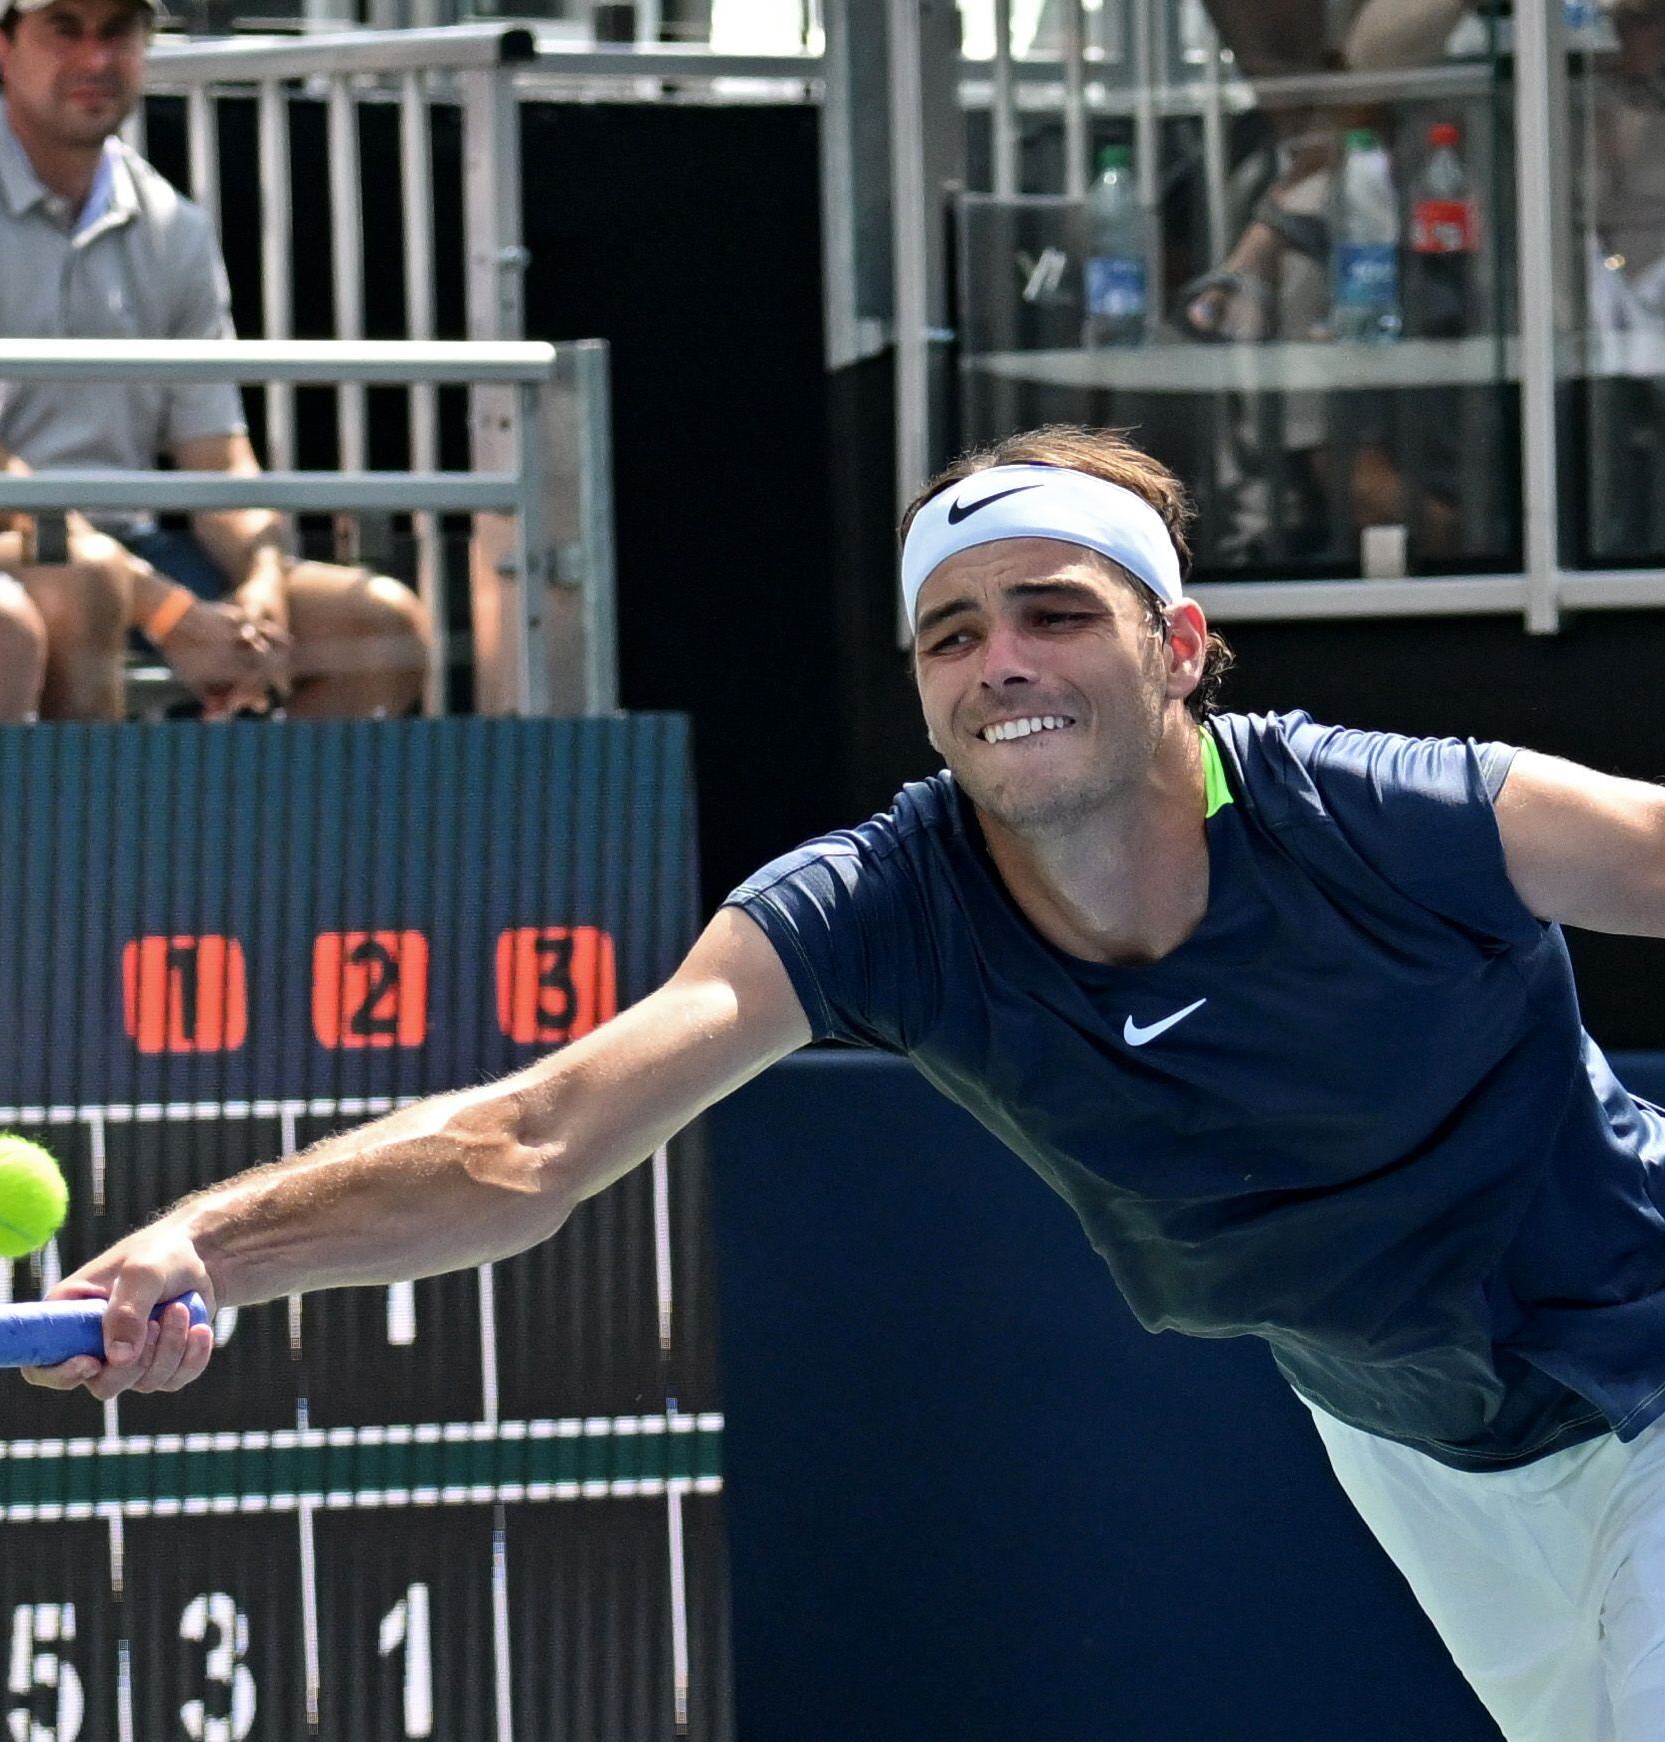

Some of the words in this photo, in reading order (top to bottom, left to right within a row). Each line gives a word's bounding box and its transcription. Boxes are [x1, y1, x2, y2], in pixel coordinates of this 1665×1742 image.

[167, 946, 198, 1041] 1
[350, 939, 399, 1035] 2
[535, 937, 578, 1030] 3
[378, 1581, 434, 1739] 1
